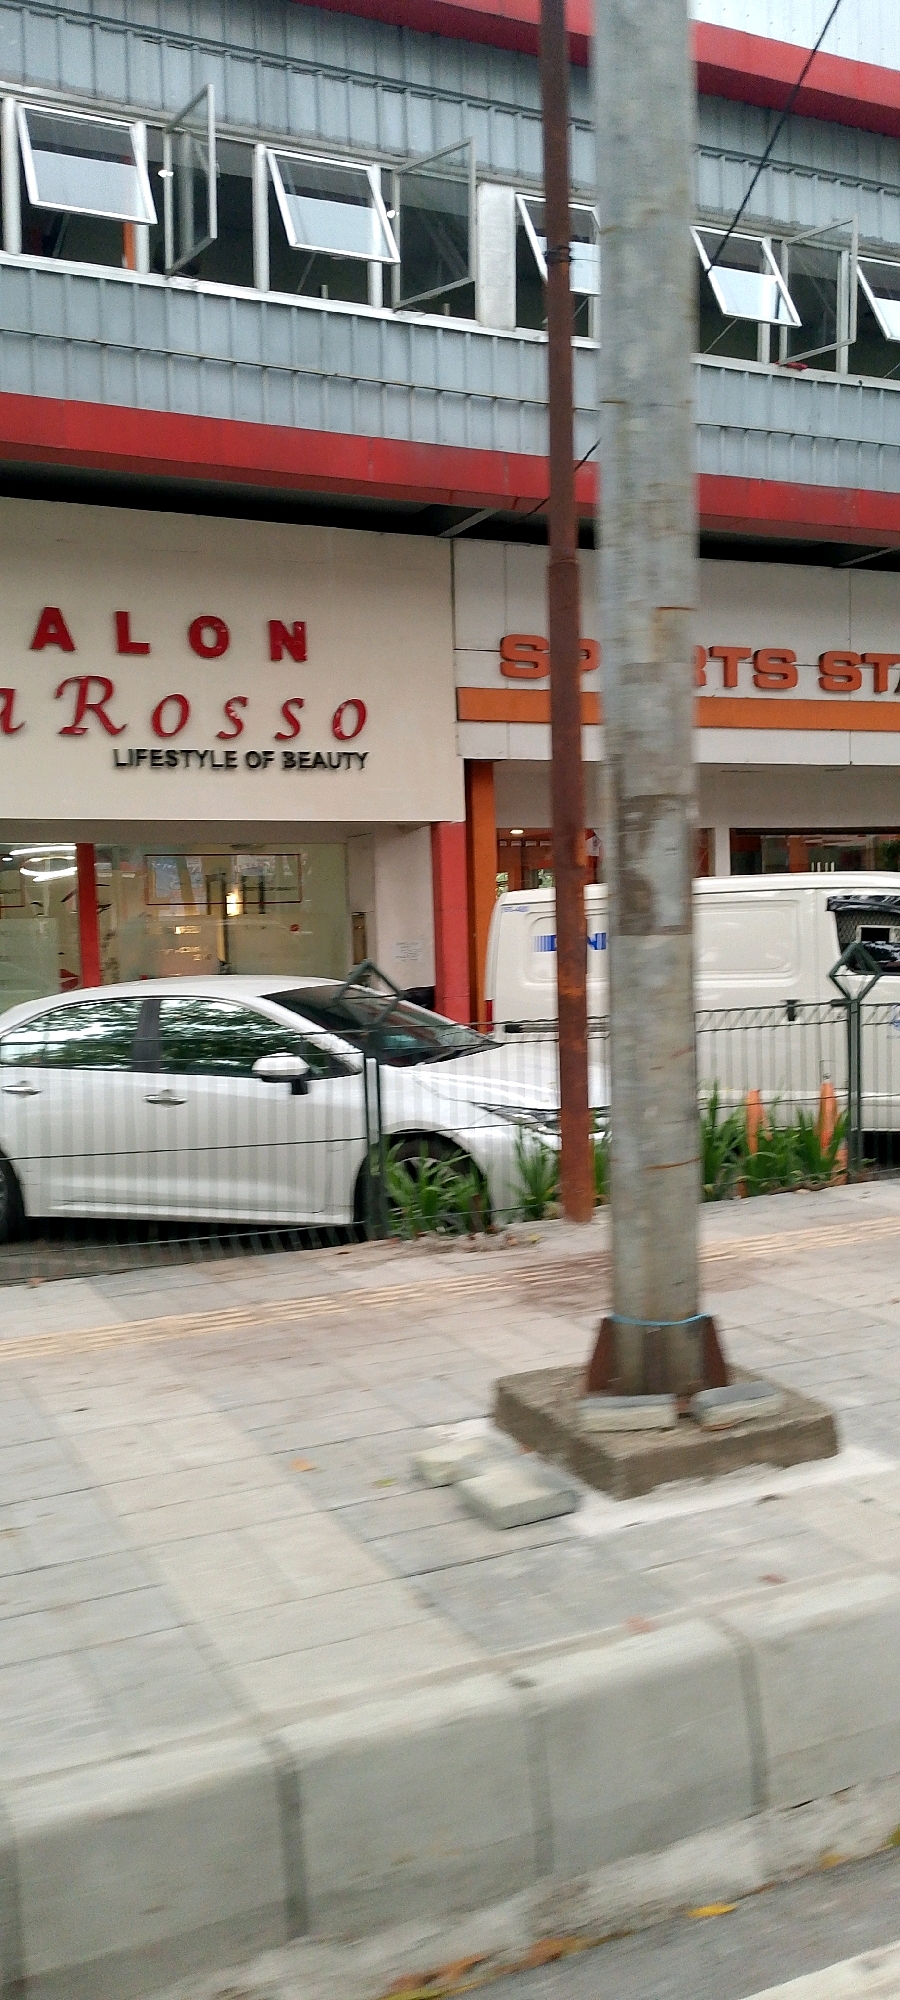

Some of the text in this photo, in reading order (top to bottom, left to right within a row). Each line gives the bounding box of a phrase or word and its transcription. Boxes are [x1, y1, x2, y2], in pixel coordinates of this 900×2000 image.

[500, 634, 900, 693] STS ST
[113, 748, 369, 770] LIFESTYLE OF BEAUTY
